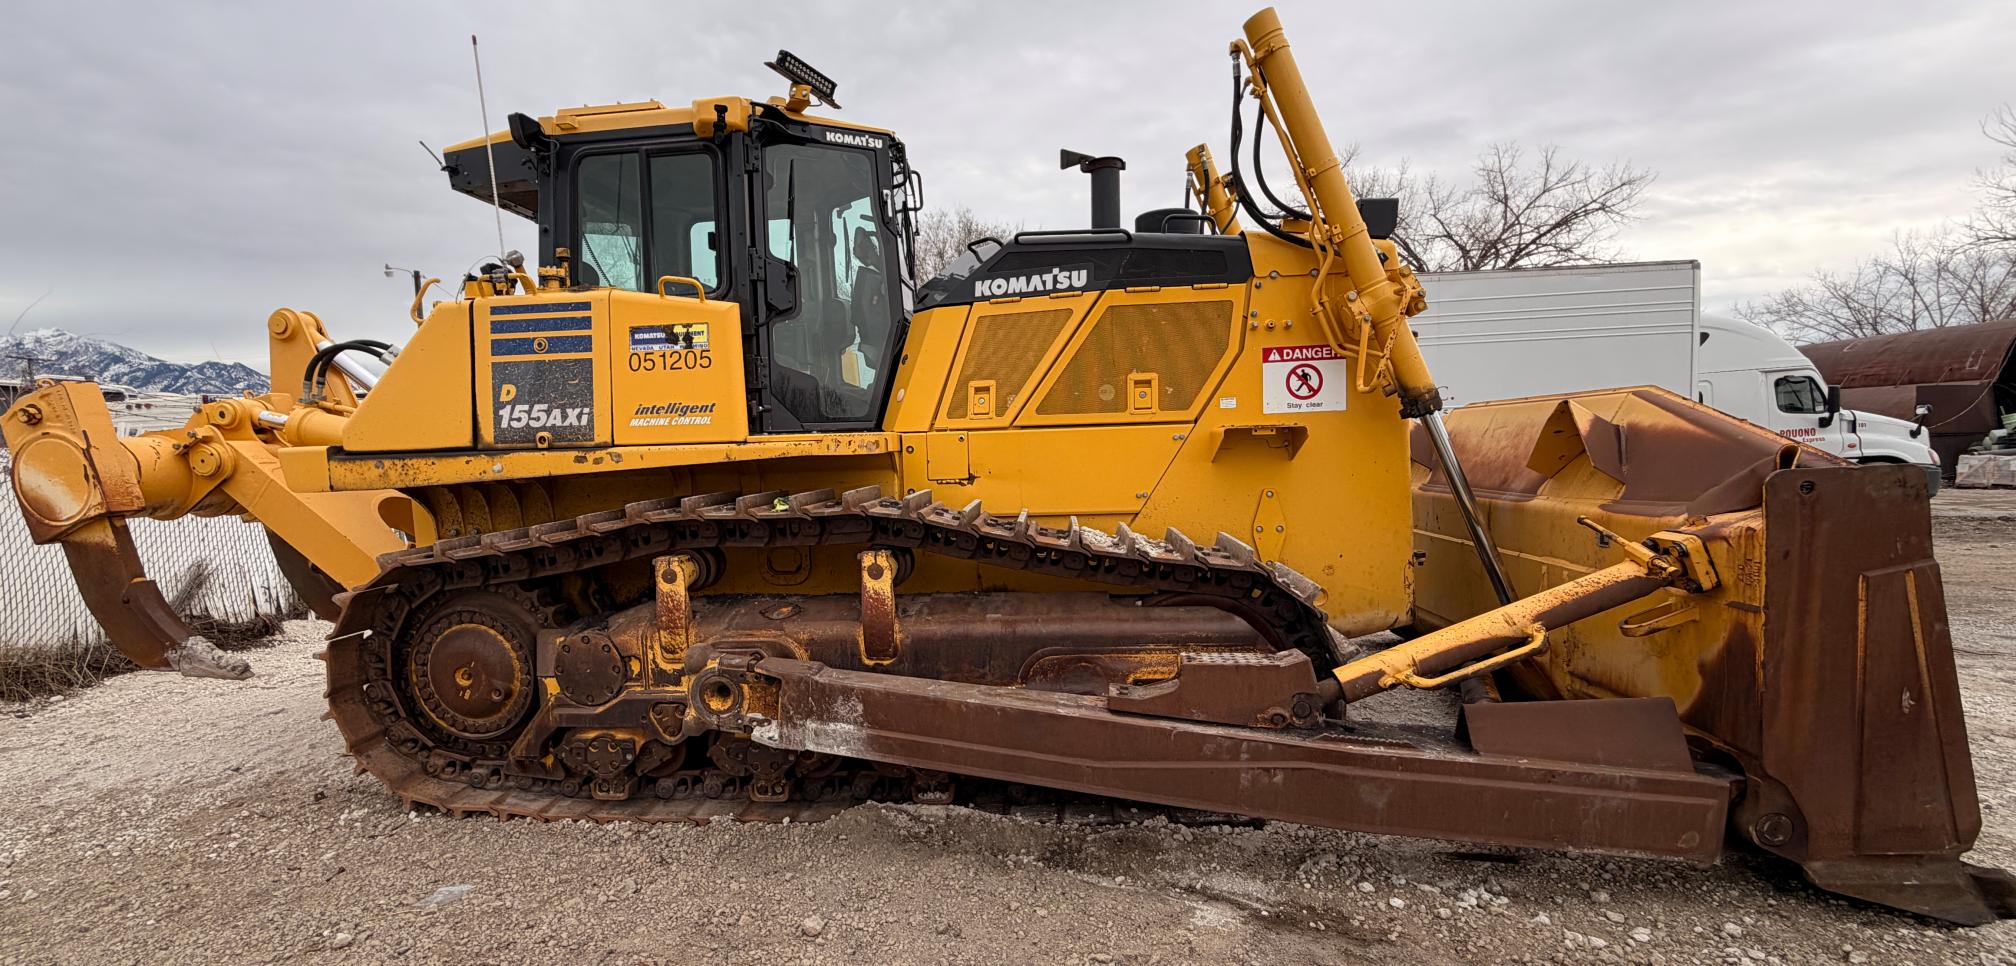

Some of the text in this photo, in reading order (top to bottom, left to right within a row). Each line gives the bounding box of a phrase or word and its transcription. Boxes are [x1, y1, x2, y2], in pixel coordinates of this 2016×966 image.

[826, 131, 883, 149] KOMATSU
[975, 267, 1088, 297] KOMATSU
[629, 350, 712, 372] 051205
[499, 384, 517, 401] D
[498, 403, 590, 428] 155AXi
[634, 402, 716, 416] intelligent
[630, 416, 712, 427] MACHINE CONTROL
